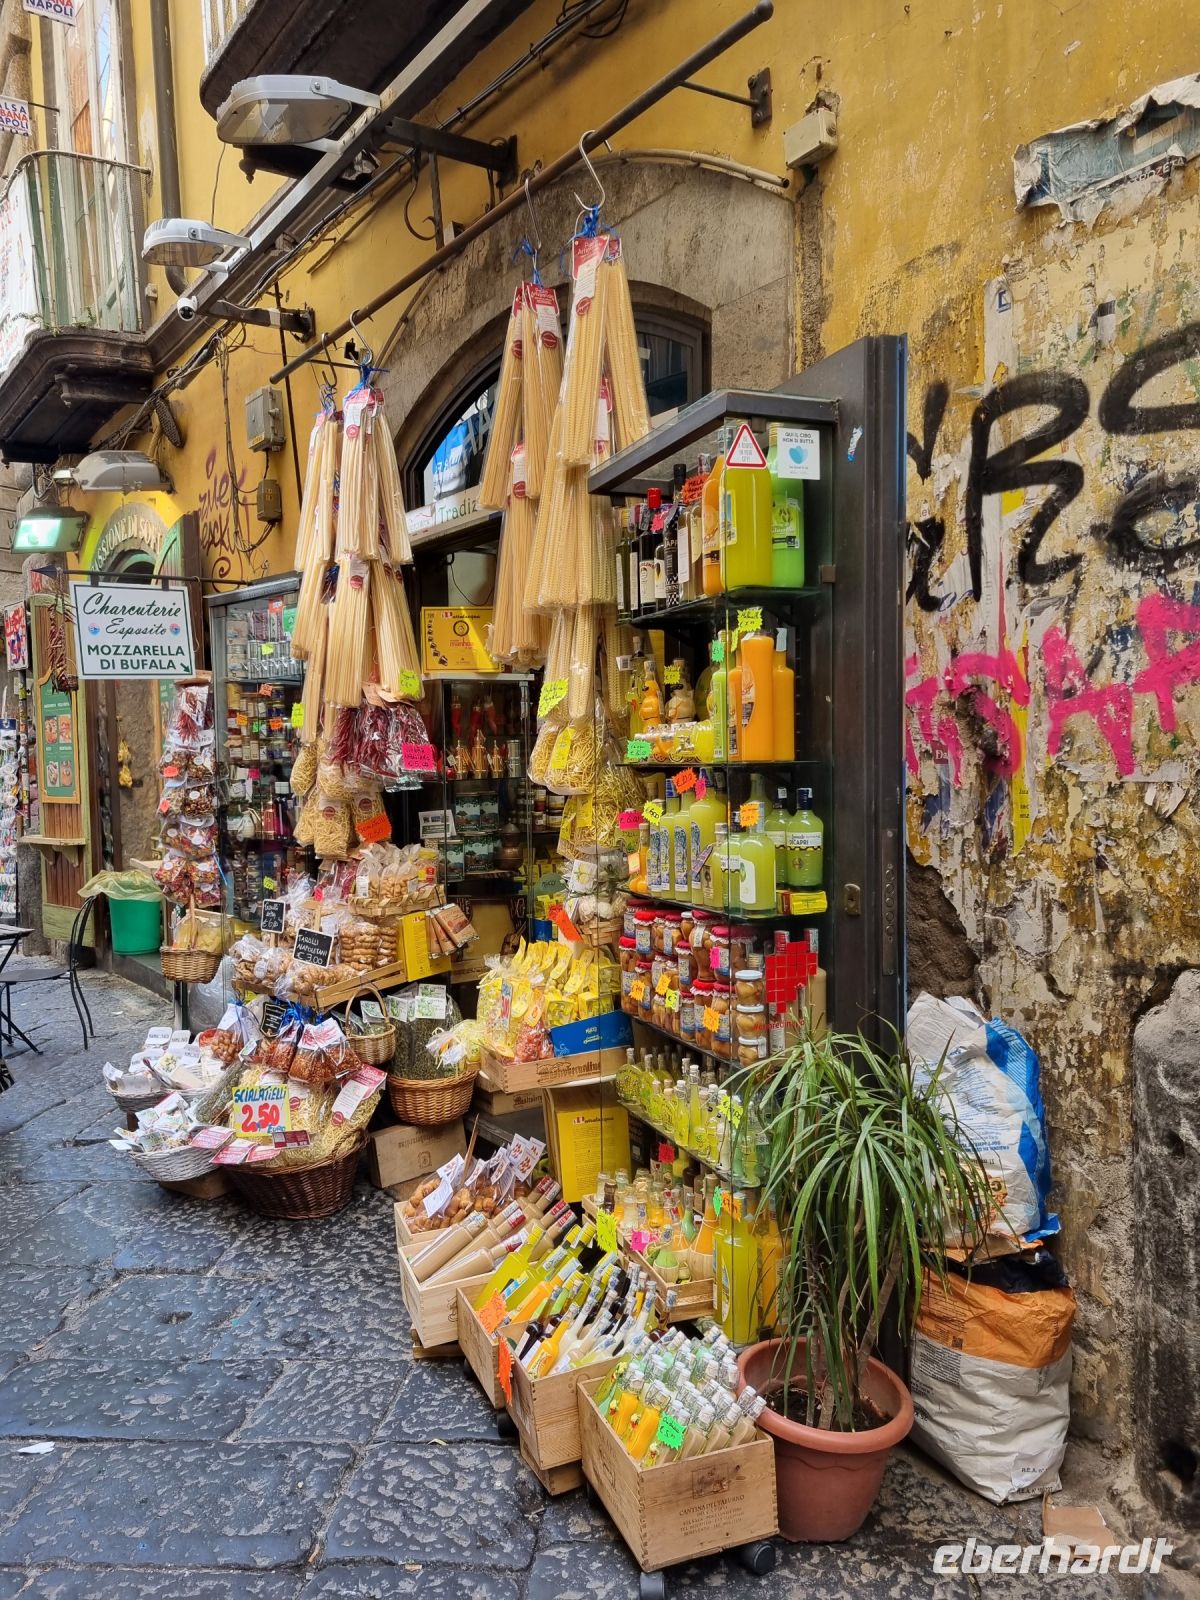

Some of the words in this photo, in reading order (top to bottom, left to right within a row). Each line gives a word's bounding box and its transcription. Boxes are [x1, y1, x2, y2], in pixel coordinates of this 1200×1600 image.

[26, 0, 73, 17] NAPOLI
[82, 592, 182, 617] Charcuterie
[105, 617, 167, 640] Esposito
[87, 644, 185, 656] MOZZARELLA
[100, 659, 116, 670] DI
[120, 659, 177, 670] BUFALA
